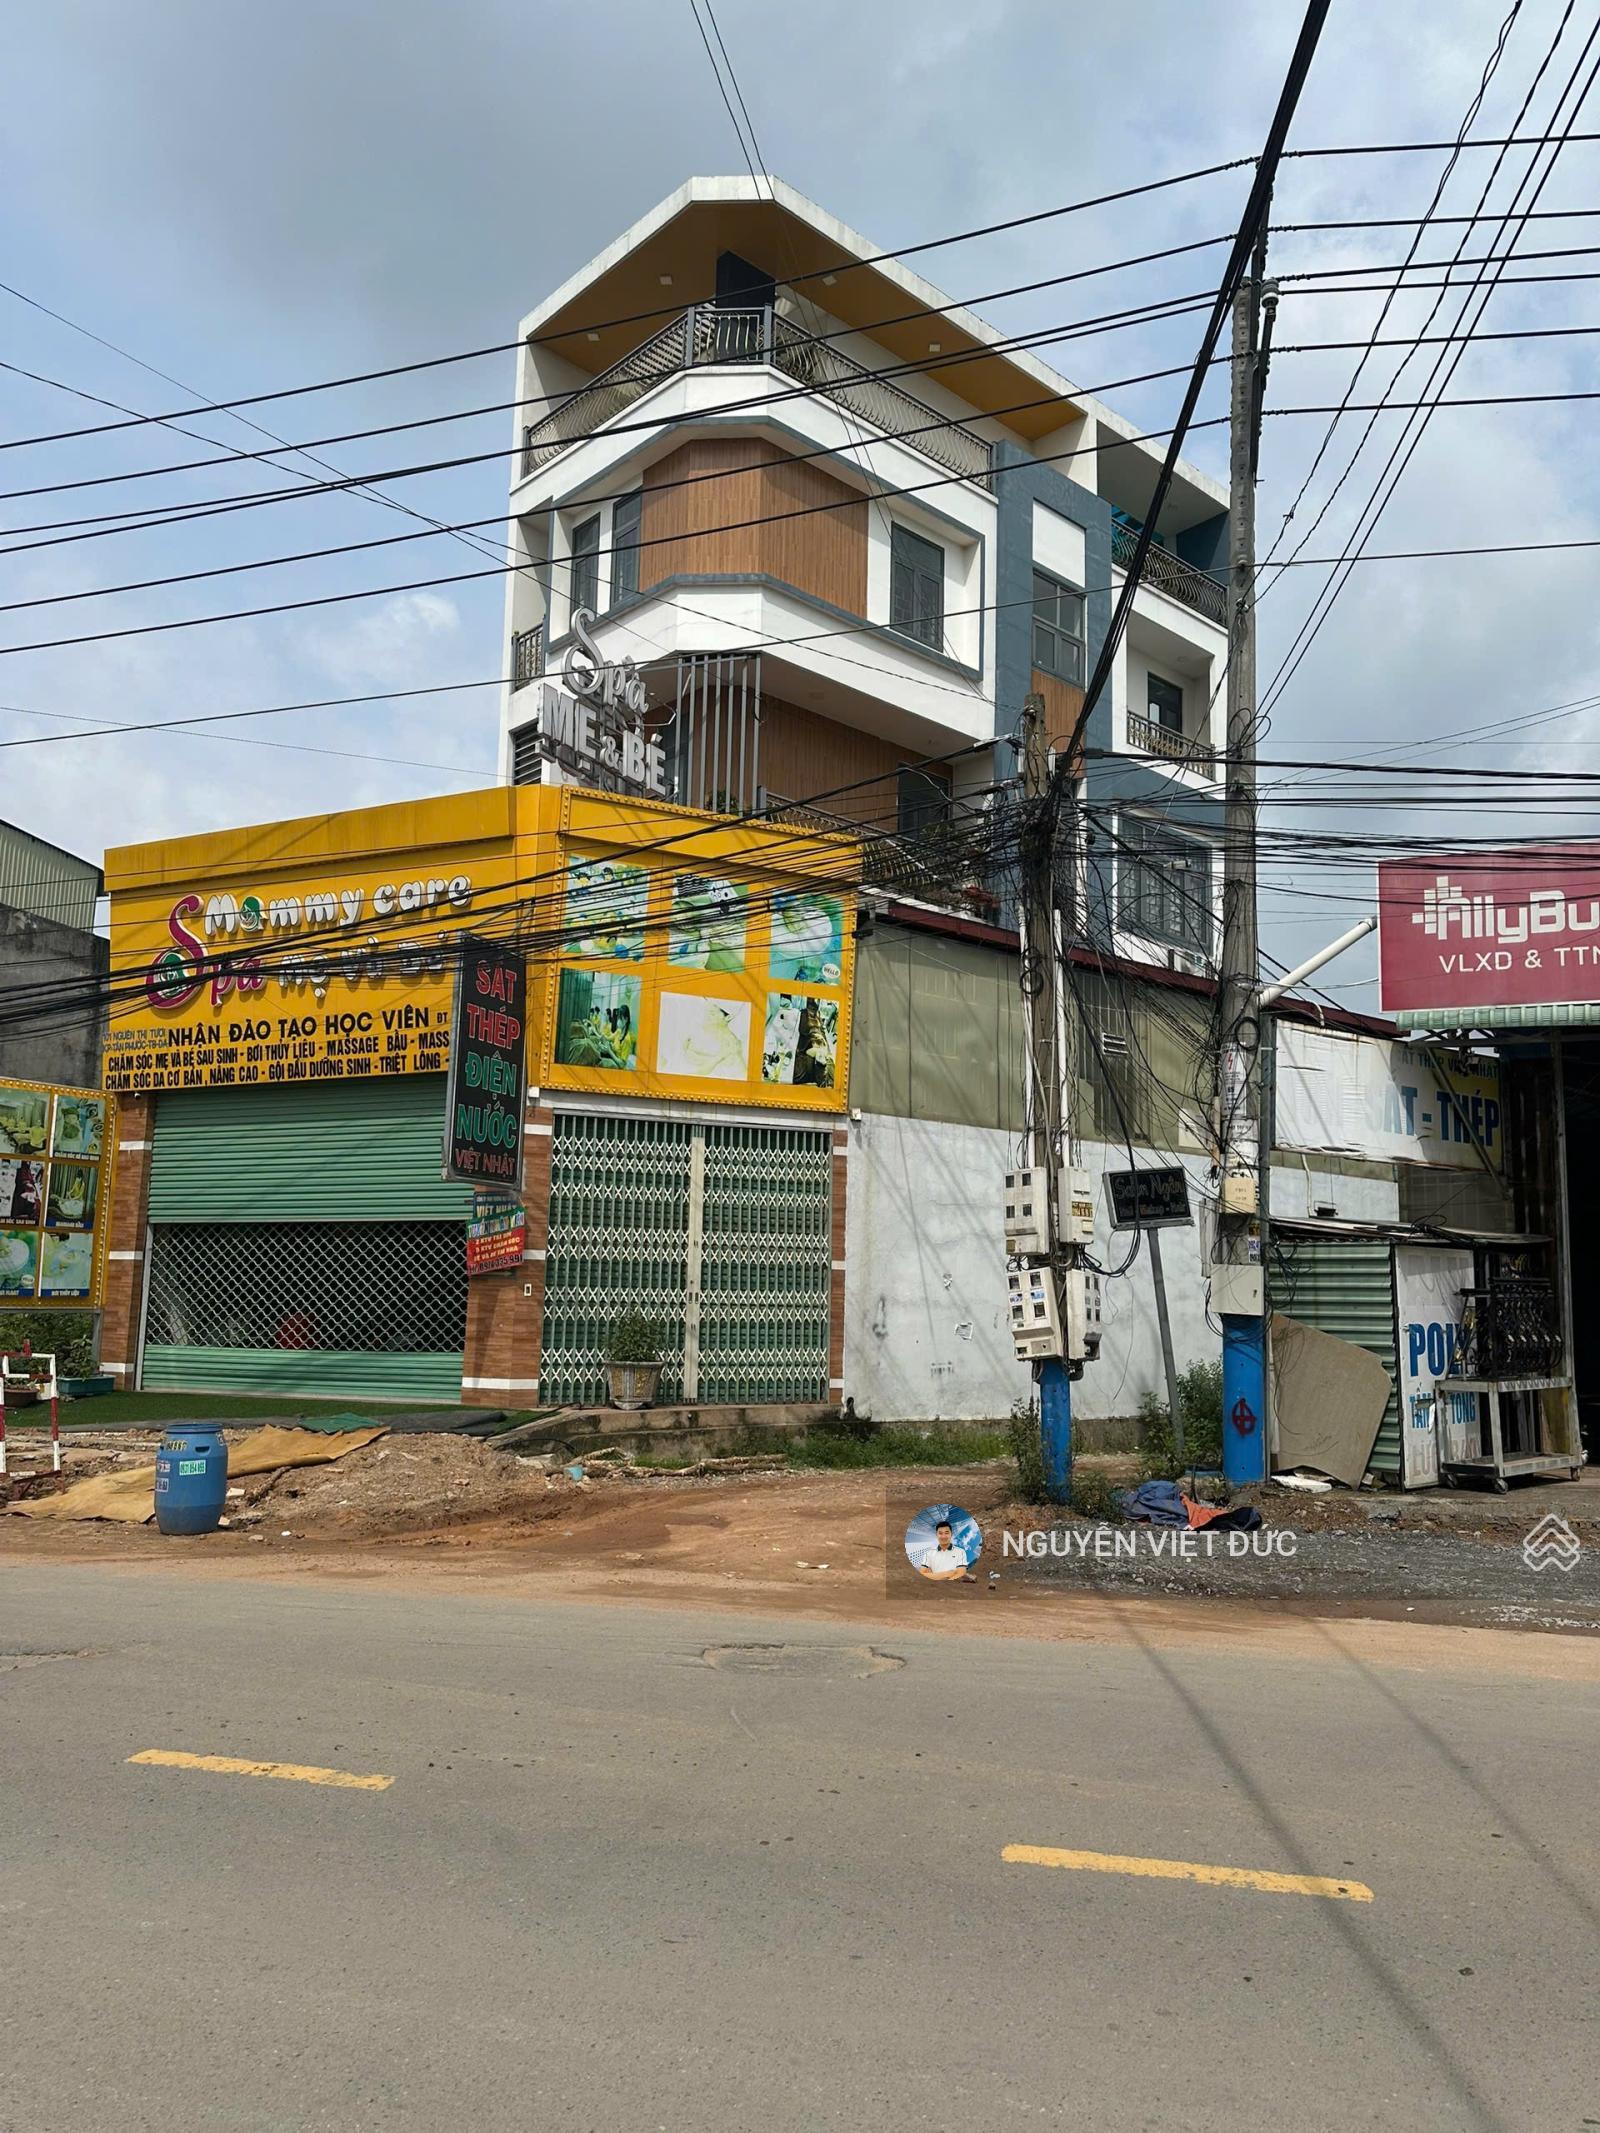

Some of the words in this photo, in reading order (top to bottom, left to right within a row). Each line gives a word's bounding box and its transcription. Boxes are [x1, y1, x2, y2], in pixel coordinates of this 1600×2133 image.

[600, 735, 620, 771] &
[618, 729, 667, 796] BÉ
[372, 875, 471, 915] care
[1438, 951, 1513, 974] VLXD
[1525, 949, 1543, 969] &
[168, 1022, 220, 1048] NHẬN
[229, 1019, 272, 1042] ĐÀO
[278, 1017, 317, 1041] TẠO
[325, 1012, 373, 1038] HỌC
[382, 1004, 429, 1030] VIÊN
[466, 1006, 520, 1050] THÉP
[108, 1053, 134, 1072] CHĂM
[136, 1050, 153, 1070] SÓC
[155, 1052, 168, 1071] MẸ
[171, 1049, 182, 1068] VÀ
[183, 1047, 195, 1067] BÉ
[196, 1050, 214, 1066] SAU
[216, 1048, 238, 1064] SINH
[247, 1044, 262, 1062] BƠI
[327, 1036, 380, 1057] MASSAGE
[134, 1069, 151, 1089] SÓC
[153, 1072, 164, 1088] DA
[167, 1070, 180, 1086] CƠ
[239, 1065, 258, 1082] CAO
[347, 1057, 371, 1075] SINH
[380, 1055, 407, 1074] TRIỆT
[414, 1050, 441, 1071] LÔNG
[465, 1050, 517, 1101] ĐIỆN
[456, 1102, 518, 1149] NƯỚC
[1436, 1089, 1500, 1147] THÉP
[455, 1146, 481, 1174] VIỆT
[482, 1151, 515, 1178] NHẬT
